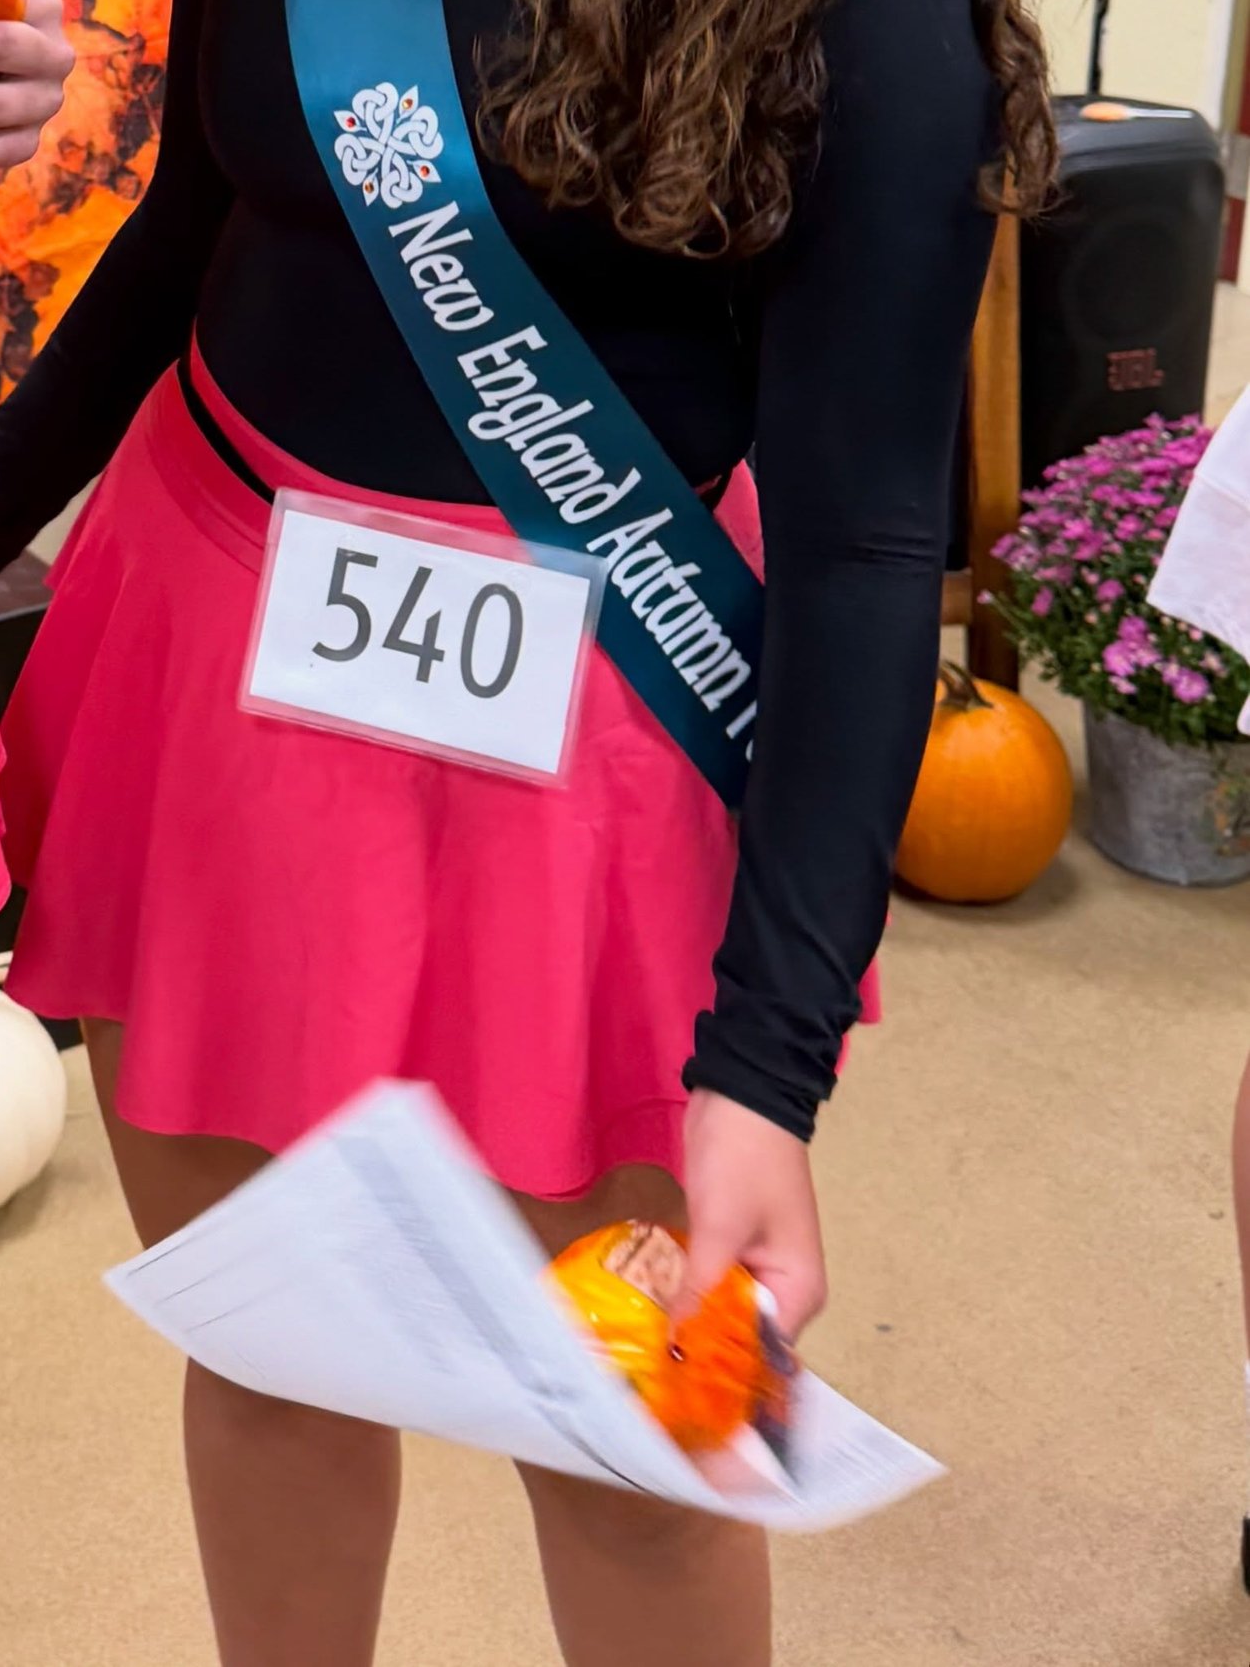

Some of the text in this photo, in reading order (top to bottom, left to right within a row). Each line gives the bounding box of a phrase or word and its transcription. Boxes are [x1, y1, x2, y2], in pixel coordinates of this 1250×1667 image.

[311, 546, 524, 699] 540
[388, 201, 751, 712] New England Autumn
